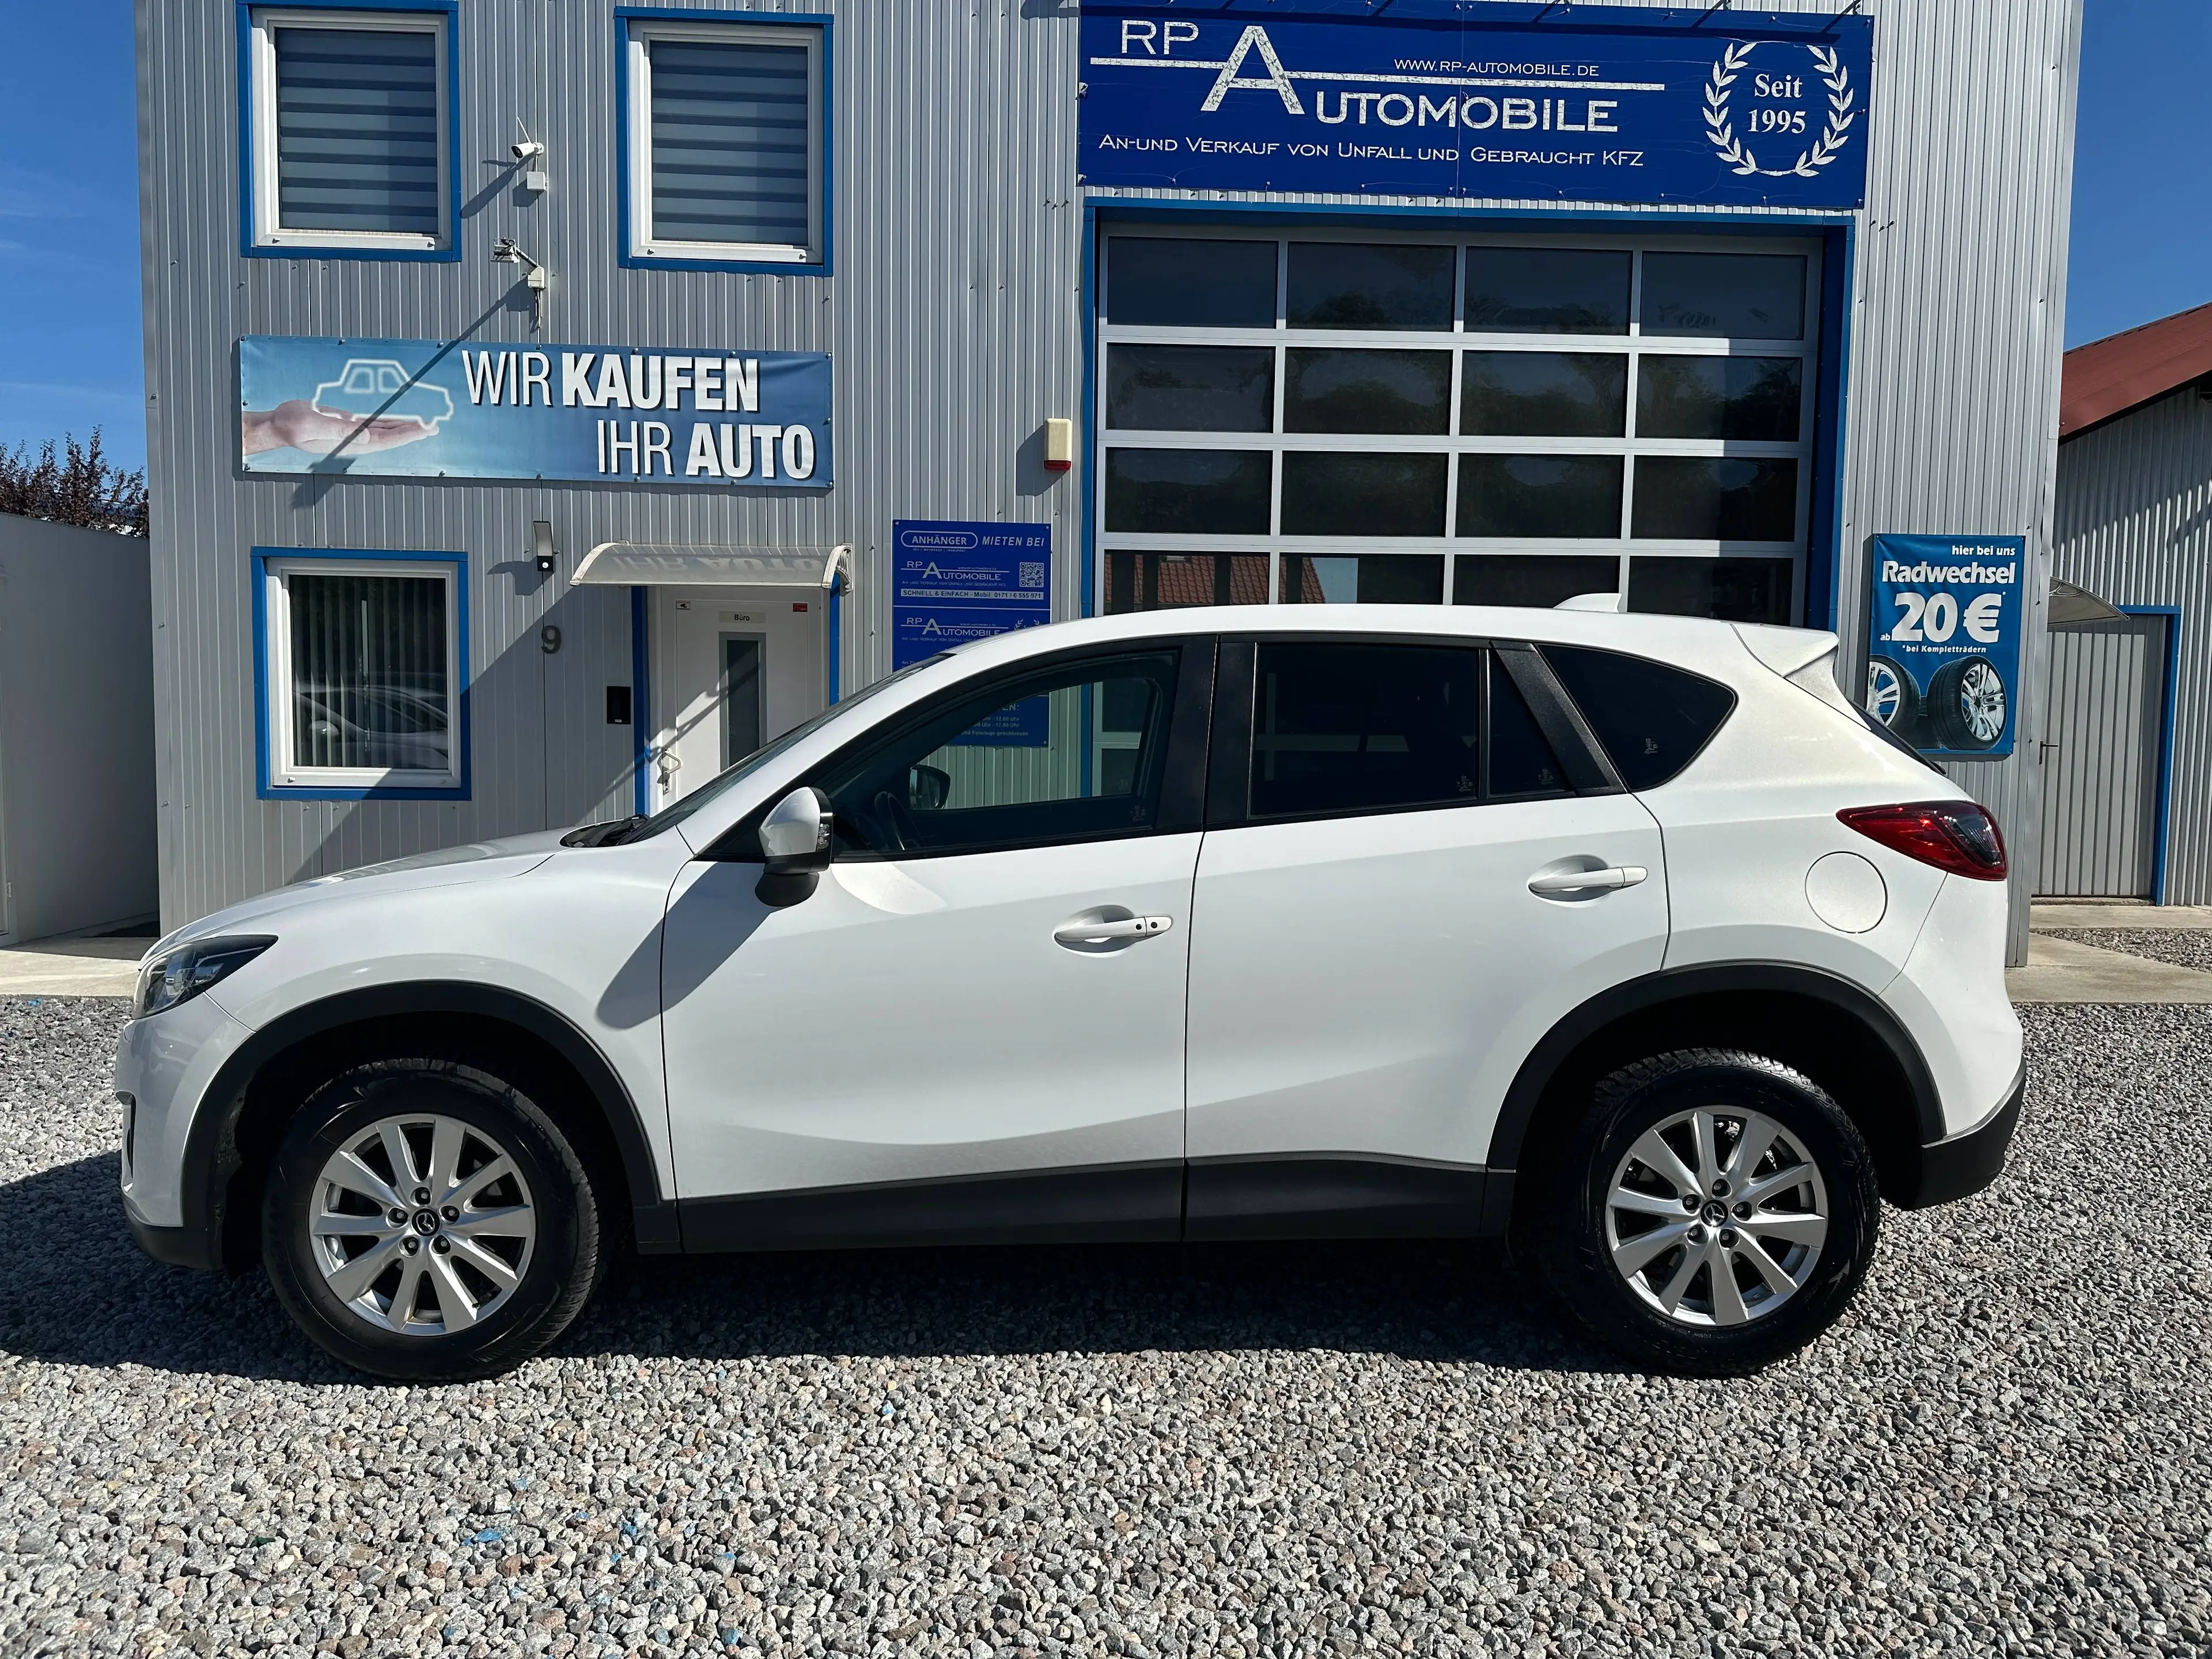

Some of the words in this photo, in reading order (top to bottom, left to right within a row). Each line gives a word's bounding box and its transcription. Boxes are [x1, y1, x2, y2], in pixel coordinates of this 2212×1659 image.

[1122, 20, 1199, 55] RP
[1393, 58, 1599, 77] WWW.RP-AUTOMOBILE.DE
[1200, 25, 1618, 132] AUTOMOBILE
[1754, 73, 1803, 98] Seit
[1747, 108, 1806, 134] 1995
[1185, 137, 1280, 155] VERKAUF
[1287, 143, 1328, 157] VON
[1338, 142, 1412, 160] UNFALL
[1418, 148, 1459, 161] UND
[1471, 146, 1595, 165] GEBRAUCHT
[1603, 150, 1643, 166] KFZ
[461, 350, 551, 406] WIR
[561, 351, 759, 412] KAUFEN
[597, 419, 673, 476] IHR
[684, 422, 816, 480] AUTO
[911, 535, 967, 546] ANHÄNGER
[982, 536, 1022, 546] MIETEN
[1026, 537, 1045, 547] BEI
[1952, 546, 1974, 556] hier
[1976, 546, 1994, 556] bei
[1996, 547, 2016, 556] uns
[907, 560, 922, 569] RP
[922, 562, 1001, 581] AUTOMOBILE
[1881, 560, 2016, 584] Radwechsel
[734, 613, 750, 622] Büro
[906, 617, 922, 625] RP
[541, 625, 562, 654] 9
[1880, 633, 1891, 641] ab
[1921, 645, 1986, 654] Kompletträdern
